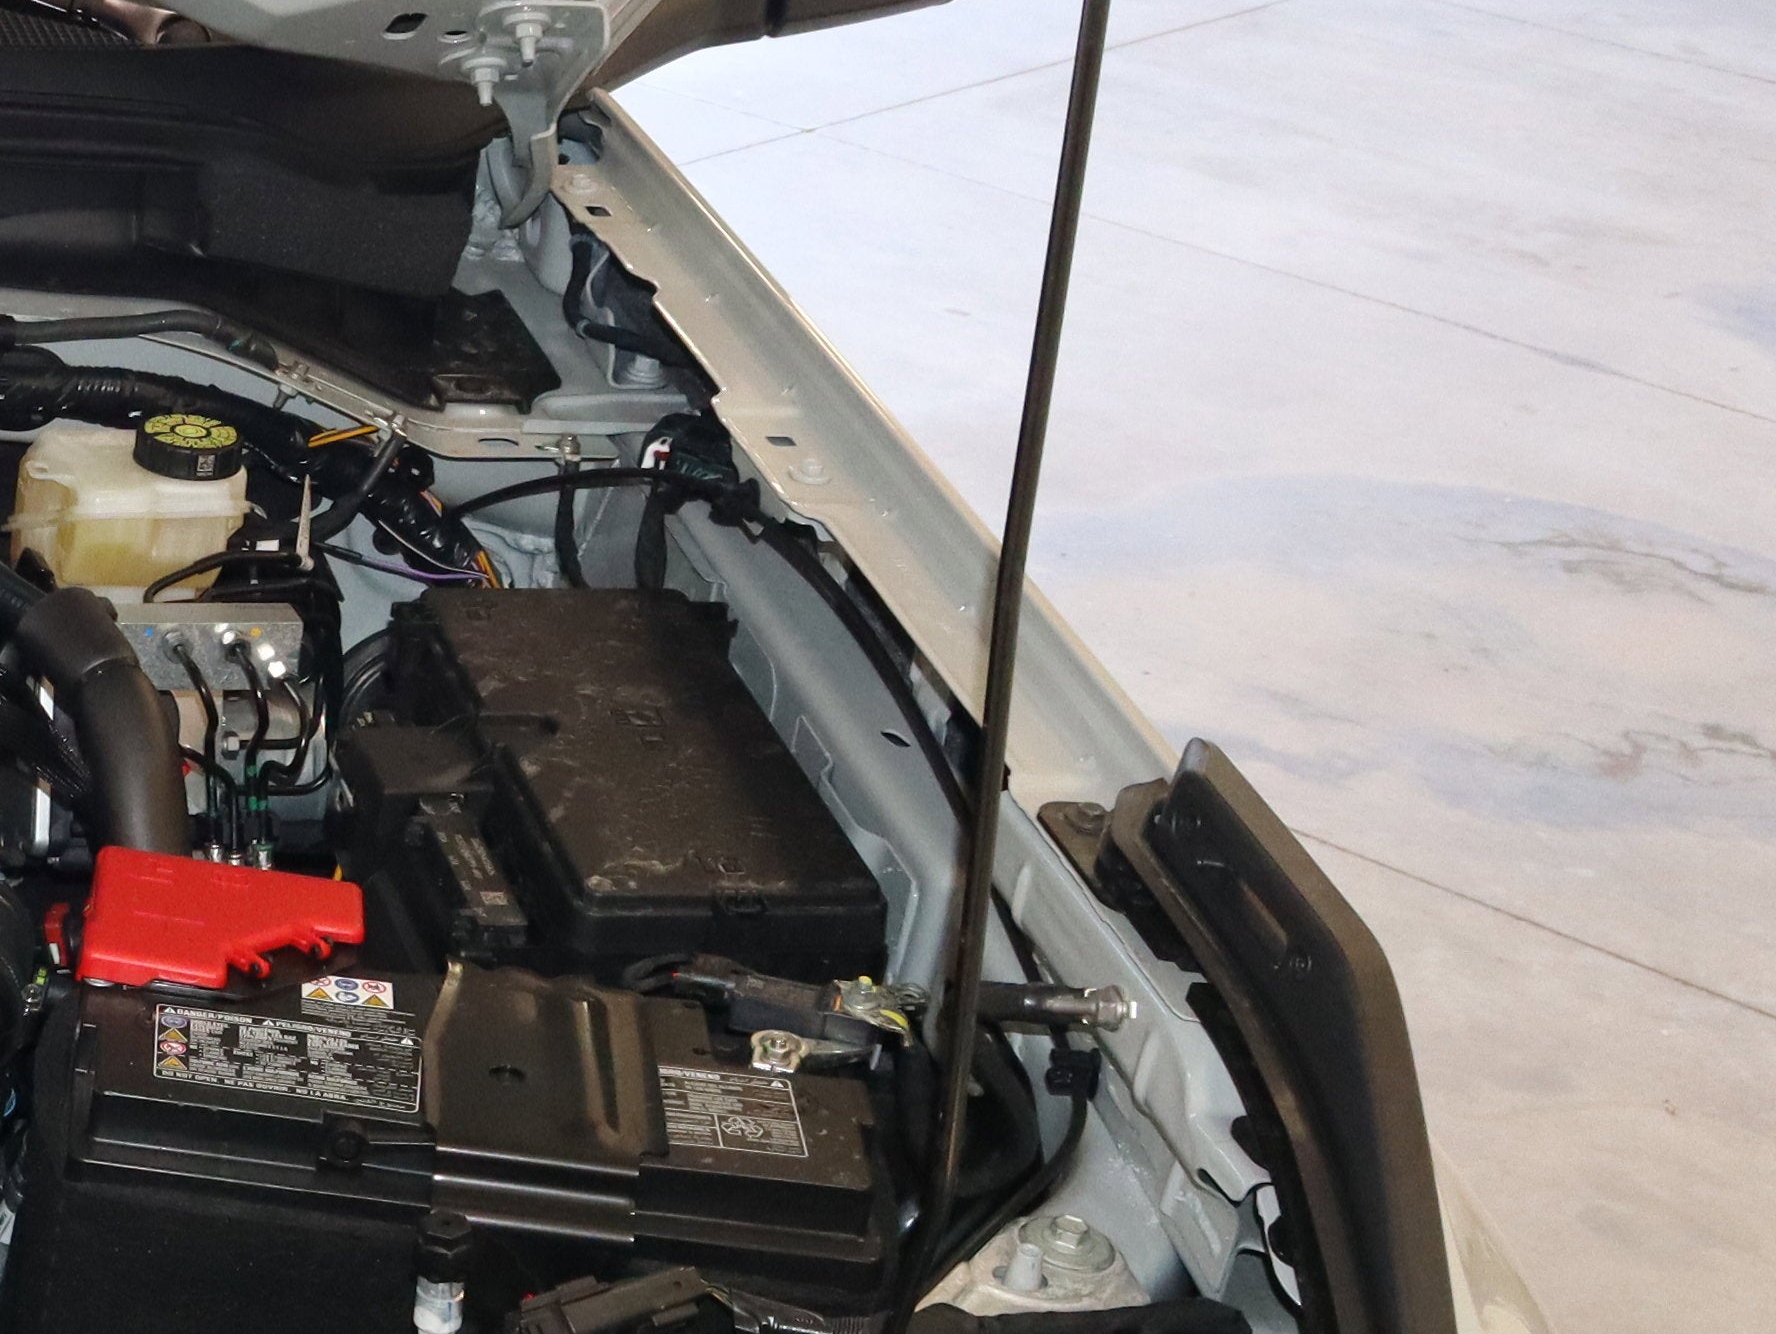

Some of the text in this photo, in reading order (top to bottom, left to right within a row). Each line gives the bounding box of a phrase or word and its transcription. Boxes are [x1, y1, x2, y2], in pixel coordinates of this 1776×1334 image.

[176, 1008, 253, 1024] DANGER/POISON
[161, 1069, 174, 1077] DO
[175, 1071, 192, 1079] NOT
[237, 1080, 255, 1088] PAS
[295, 1087, 308, 1095] NO
[310, 1089, 322, 1097] LA
